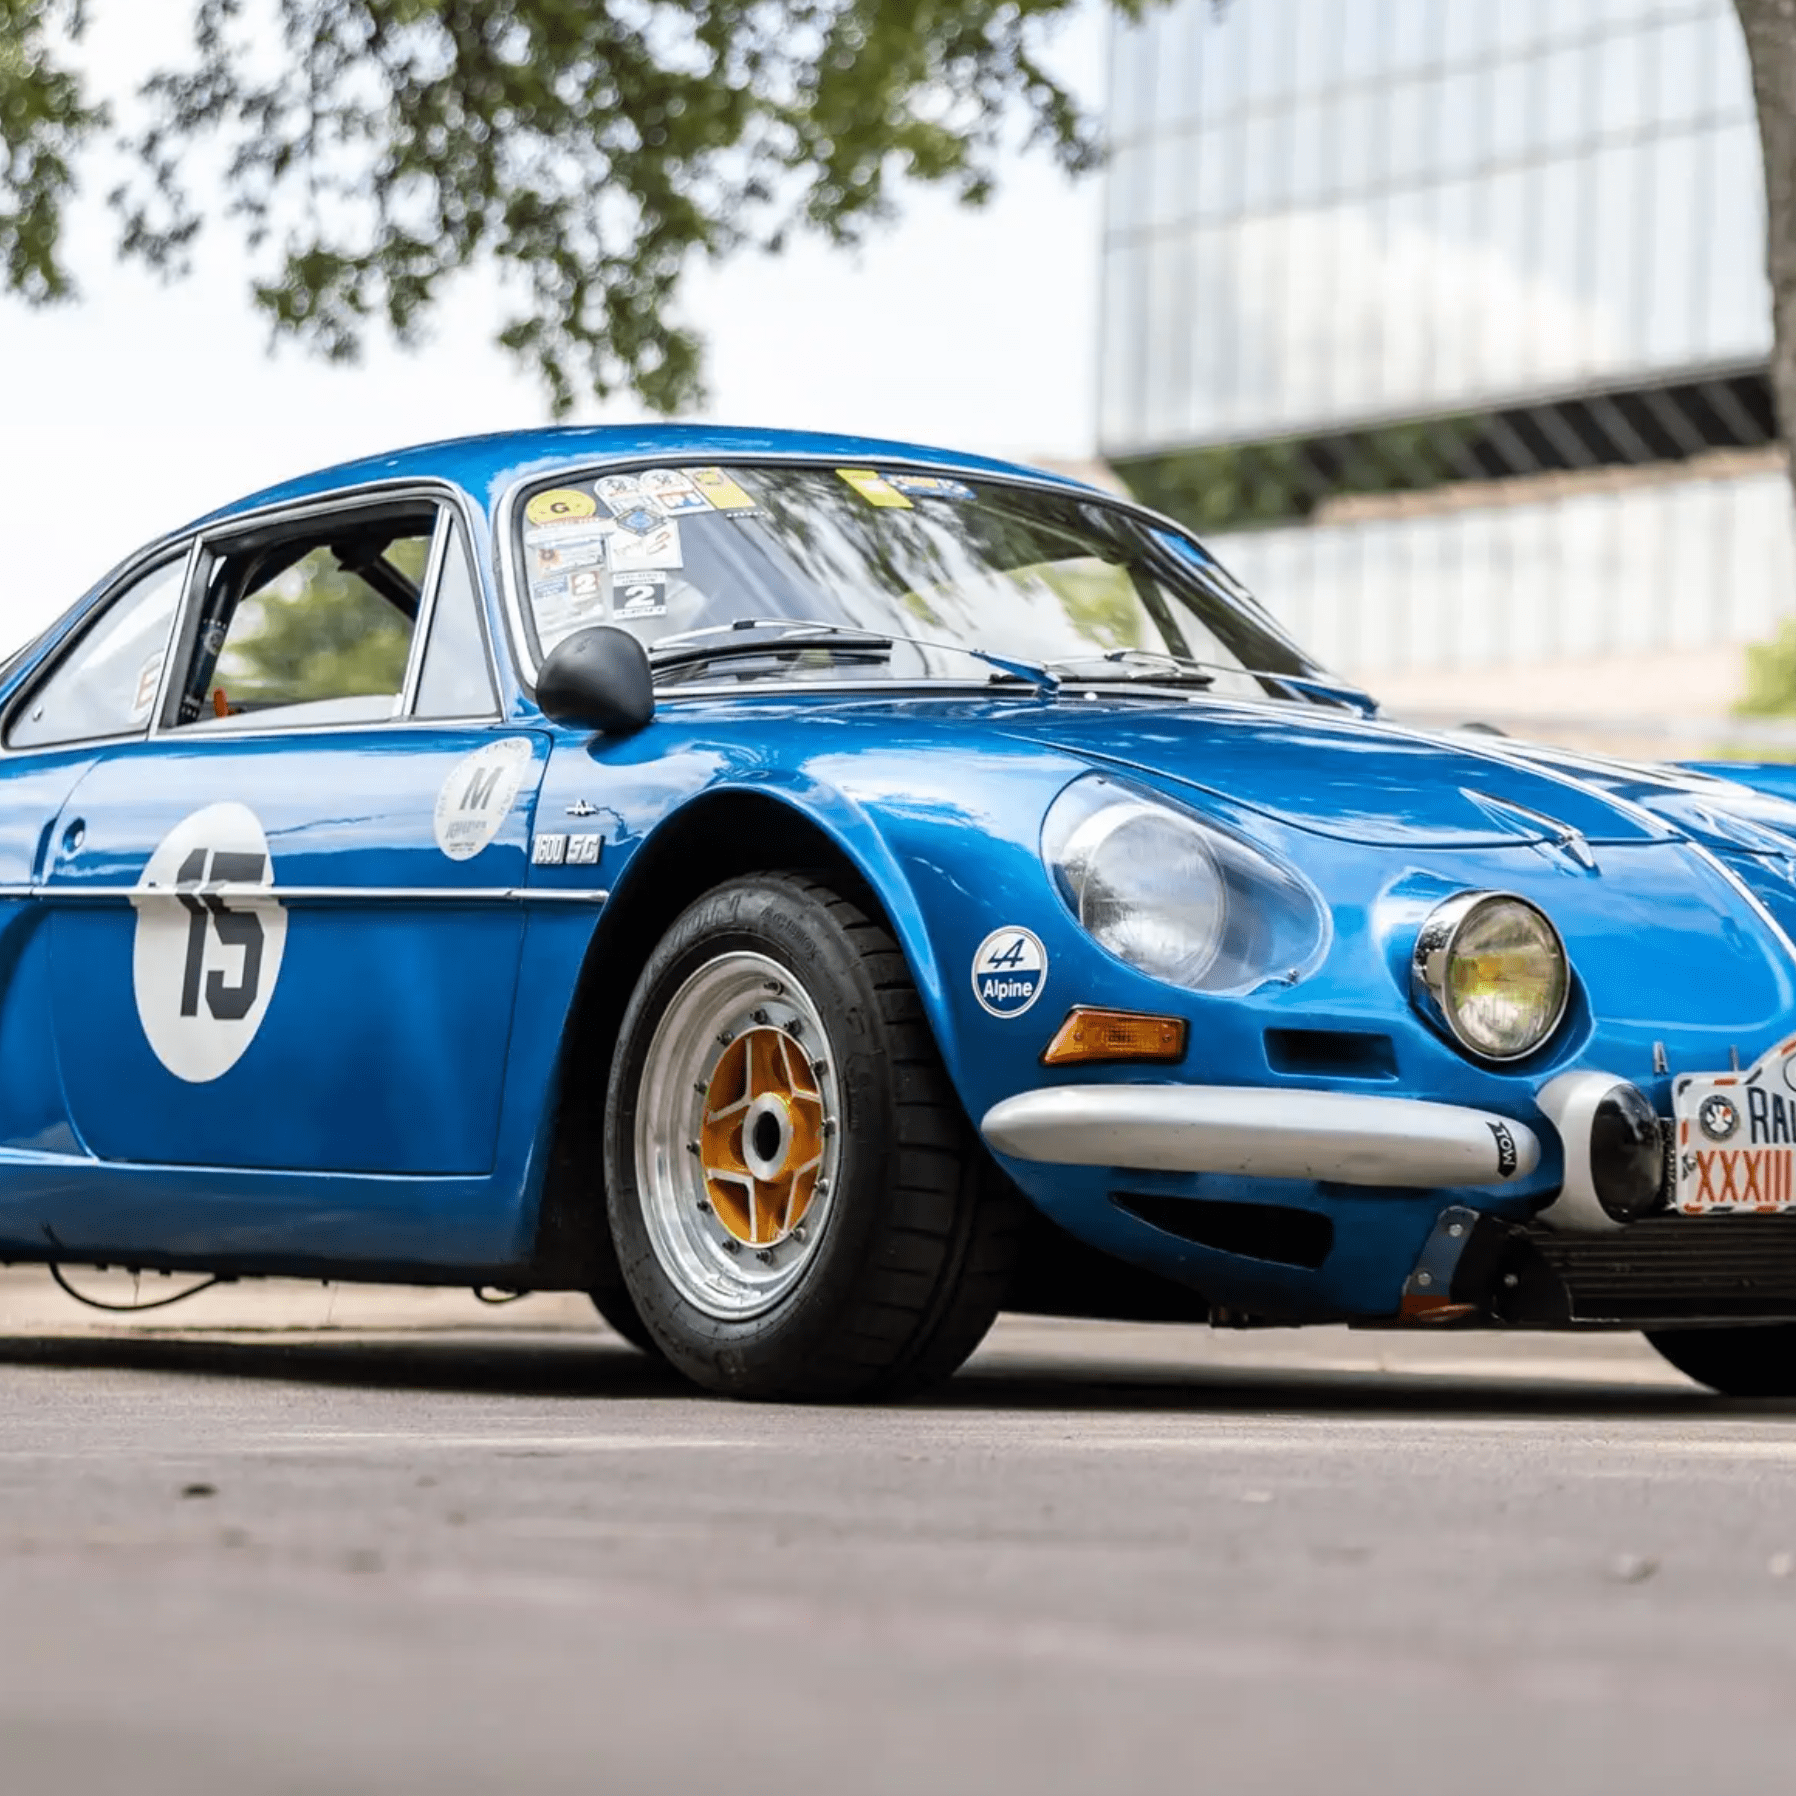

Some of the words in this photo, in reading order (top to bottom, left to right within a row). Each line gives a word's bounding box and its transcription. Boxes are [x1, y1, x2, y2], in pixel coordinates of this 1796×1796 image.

[550, 501, 570, 514] G
[574, 573, 597, 594] 2
[624, 585, 655, 608] 2
[460, 766, 505, 811] M
[175, 847, 268, 1020] 15
[983, 978, 1033, 1002] Alpine
[1495, 1127, 1516, 1165] TOW
[1696, 1149, 1793, 1202] XXXIII
